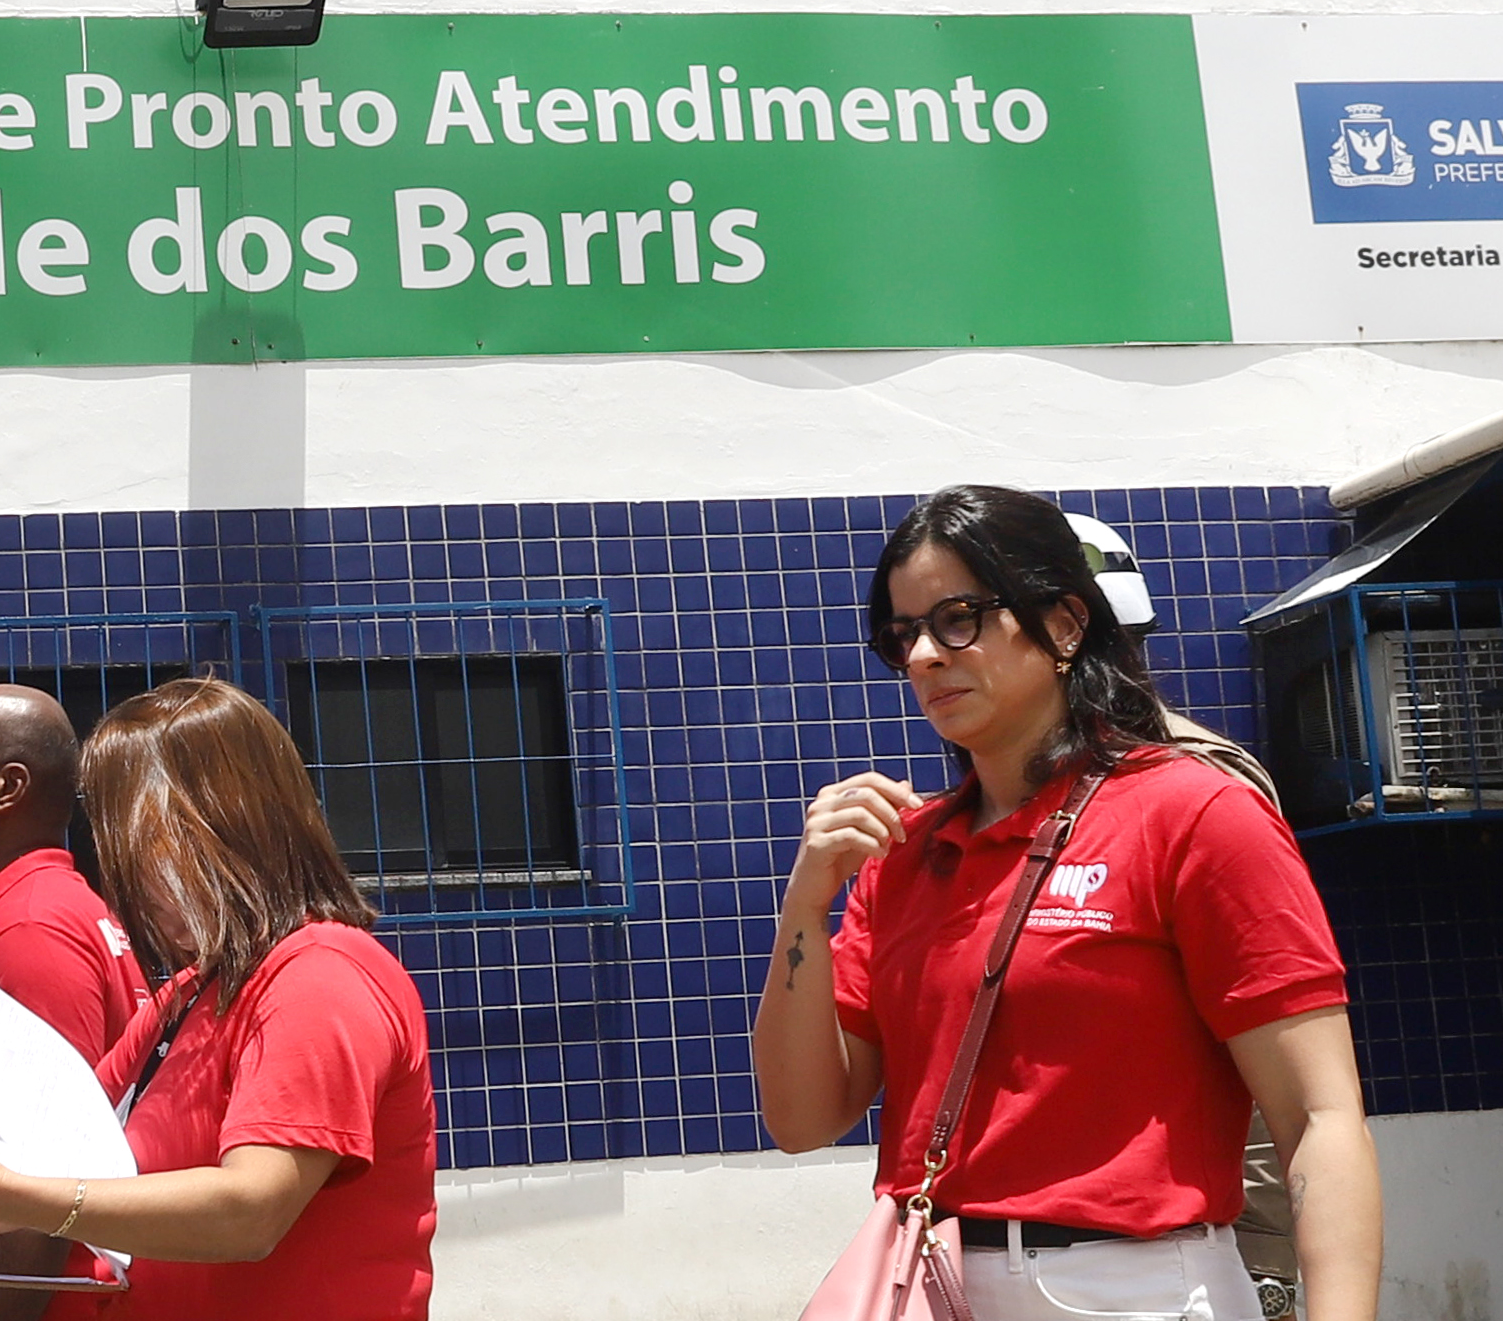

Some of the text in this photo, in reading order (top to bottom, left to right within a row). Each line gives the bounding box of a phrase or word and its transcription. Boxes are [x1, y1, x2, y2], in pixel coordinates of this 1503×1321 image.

[64, 72, 399, 151] Pronto
[424, 63, 1050, 146] Atendimento
[126, 185, 360, 296] dos
[393, 179, 767, 291] Barris
[1357, 246, 1500, 269] Secretaria
